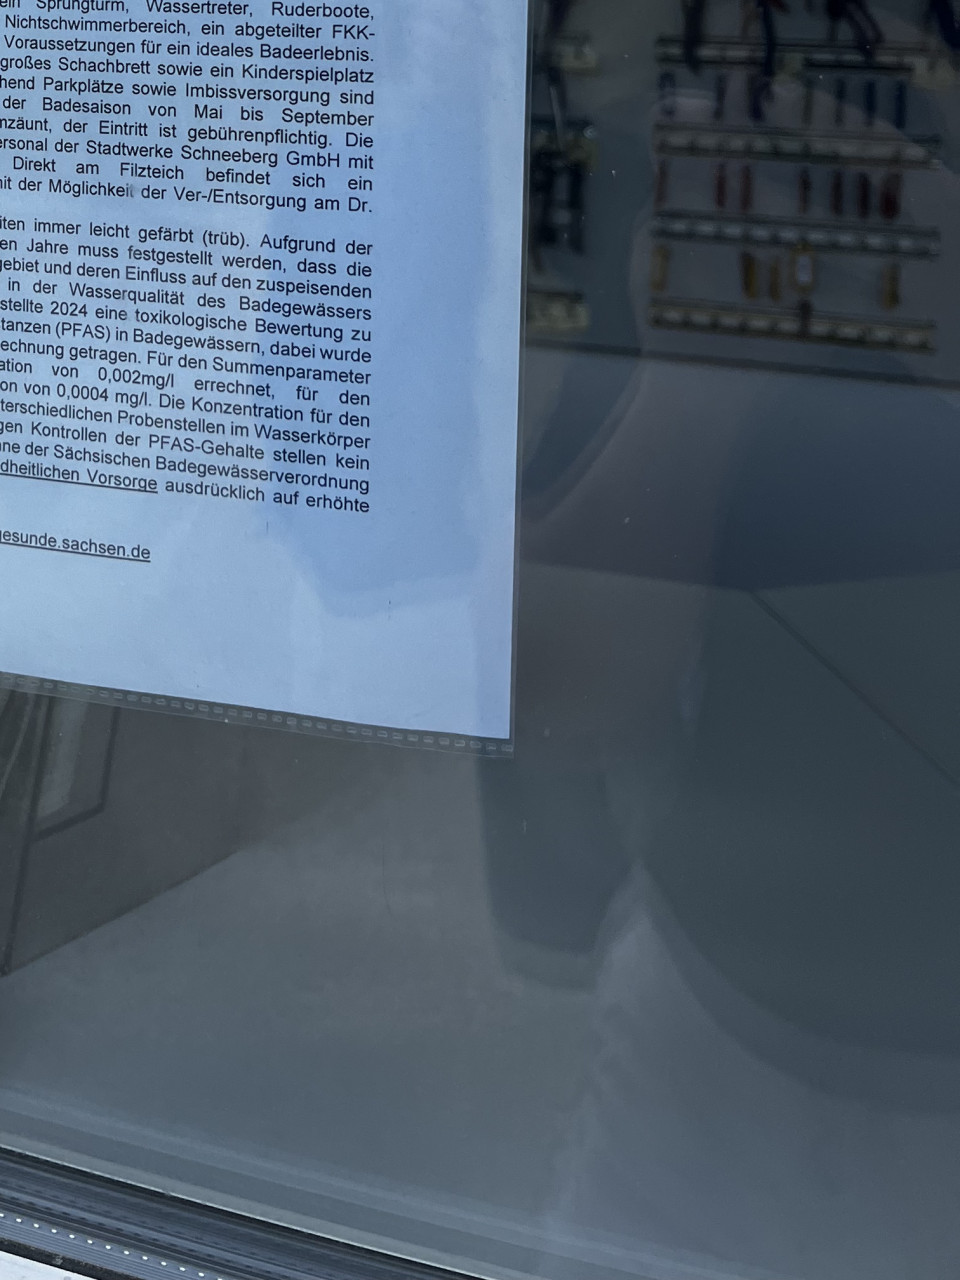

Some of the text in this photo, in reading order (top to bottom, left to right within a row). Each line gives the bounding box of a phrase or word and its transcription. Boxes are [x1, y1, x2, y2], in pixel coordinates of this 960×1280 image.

[271, 0, 373, 20] Ruderboote,
[0, 54, 51, 72] großes
[58, 56, 150, 74] Schachbrett
[157, 61, 203, 76] sowie
[210, 62, 233, 77] ein
[242, 63, 374, 85] Kinderspielplatz
[63, 118, 88, 133] der
[99, 119, 148, 137] Eintritt
[159, 123, 177, 138] ist
[187, 125, 332, 149] gebührenpflichtig.
[345, 131, 373, 148] Die
[13, 155, 56, 172] Direkt
[75, 162, 99, 175] am
[120, 161, 184, 180] Filzteich
[206, 166, 270, 185] befindet
[292, 172, 325, 188] sich
[347, 175, 372, 191] ein
[26, 237, 69, 255] Jahre
[77, 244, 119, 259] muss
[127, 244, 213, 266] festgestellt
[221, 254, 286, 273] werden,
[296, 256, 337, 275] dass
[346, 260, 372, 277] die
[50, 300, 88, 317] 2024
[95, 304, 127, 321] eine
[134, 308, 247, 331] toxikologische
[255, 317, 343, 343] Bewertung
[350, 329, 371, 342] zu
[51, 364, 78, 378] von
[97, 365, 174, 391] 0,002mg/l
[193, 378, 274, 399] errechnet,
[295, 384, 318, 401] für
[338, 388, 369, 406] den
[24, 440, 49, 457] der
[53, 443, 150, 469] Sächsischen
[155, 455, 369, 496] Badegewässerverordnung
